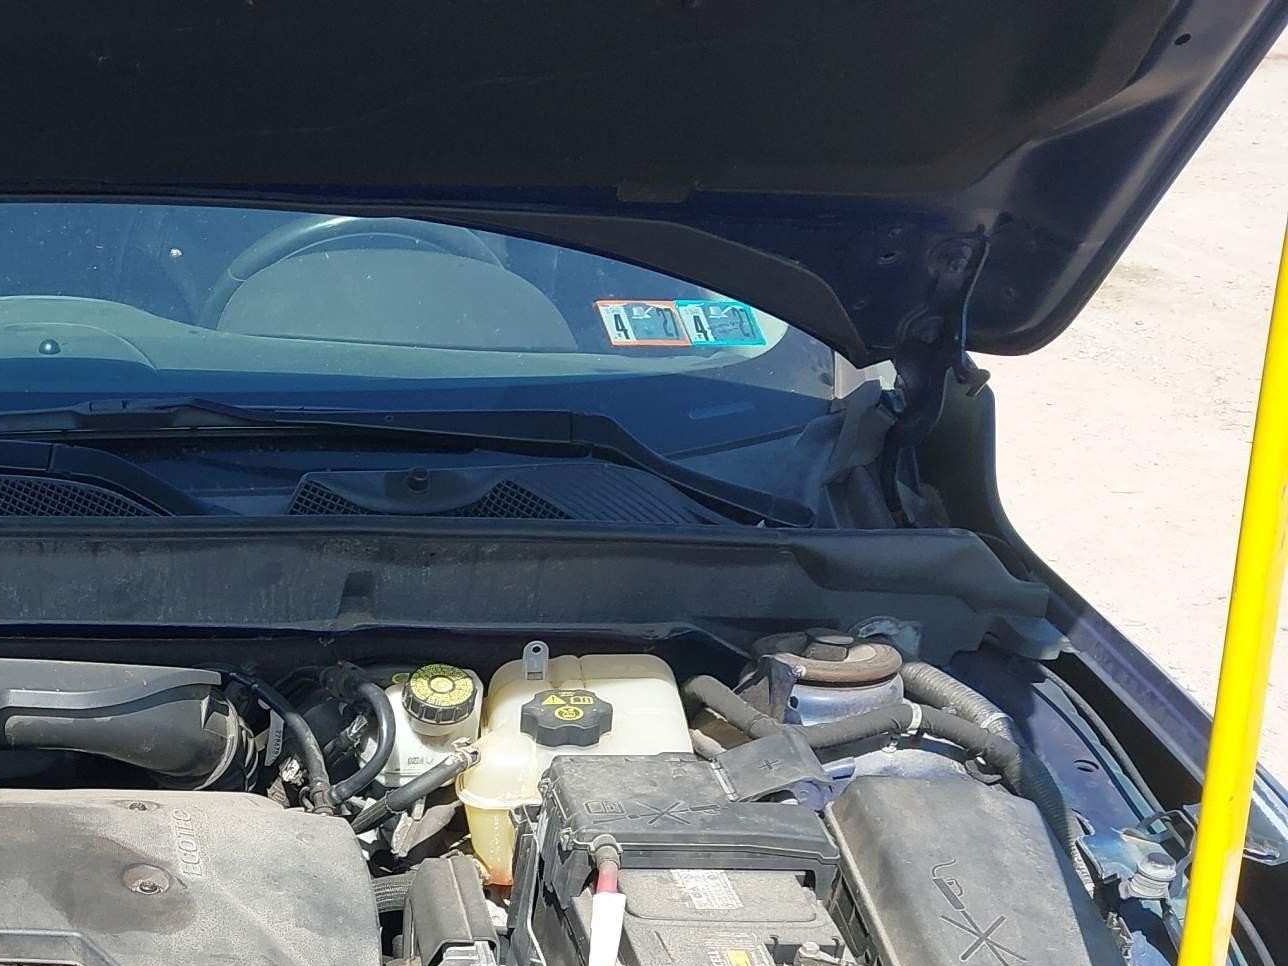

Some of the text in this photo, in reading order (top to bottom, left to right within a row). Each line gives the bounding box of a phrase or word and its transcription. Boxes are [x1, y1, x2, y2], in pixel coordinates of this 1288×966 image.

[613, 314, 630, 339] 4
[693, 315, 709, 341] 4
[172, 808, 203, 877] ECOTEC
